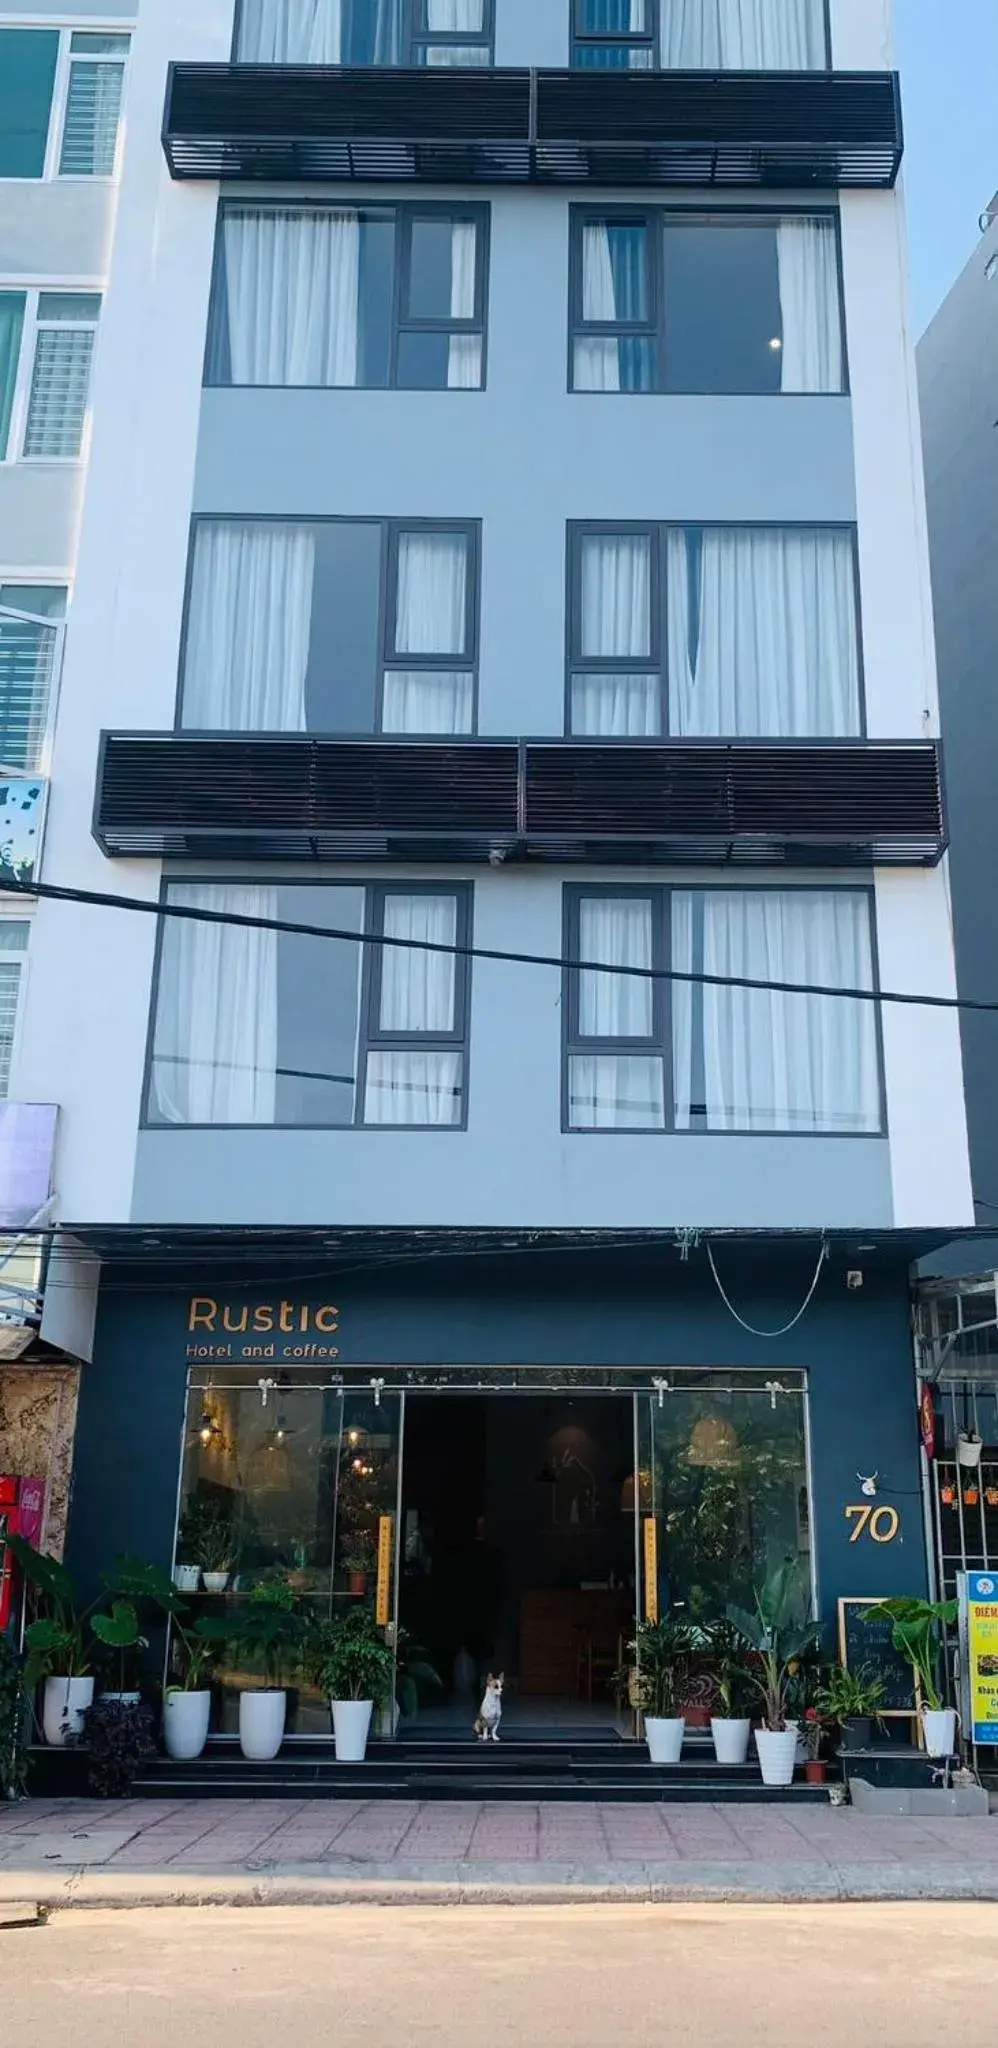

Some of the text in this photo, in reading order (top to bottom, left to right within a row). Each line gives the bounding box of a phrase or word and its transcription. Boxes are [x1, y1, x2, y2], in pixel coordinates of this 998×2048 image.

[188, 1297, 340, 1332] Rustic
[186, 1343, 339, 1357] Hotel and coffee
[845, 1505, 898, 1542] 70
